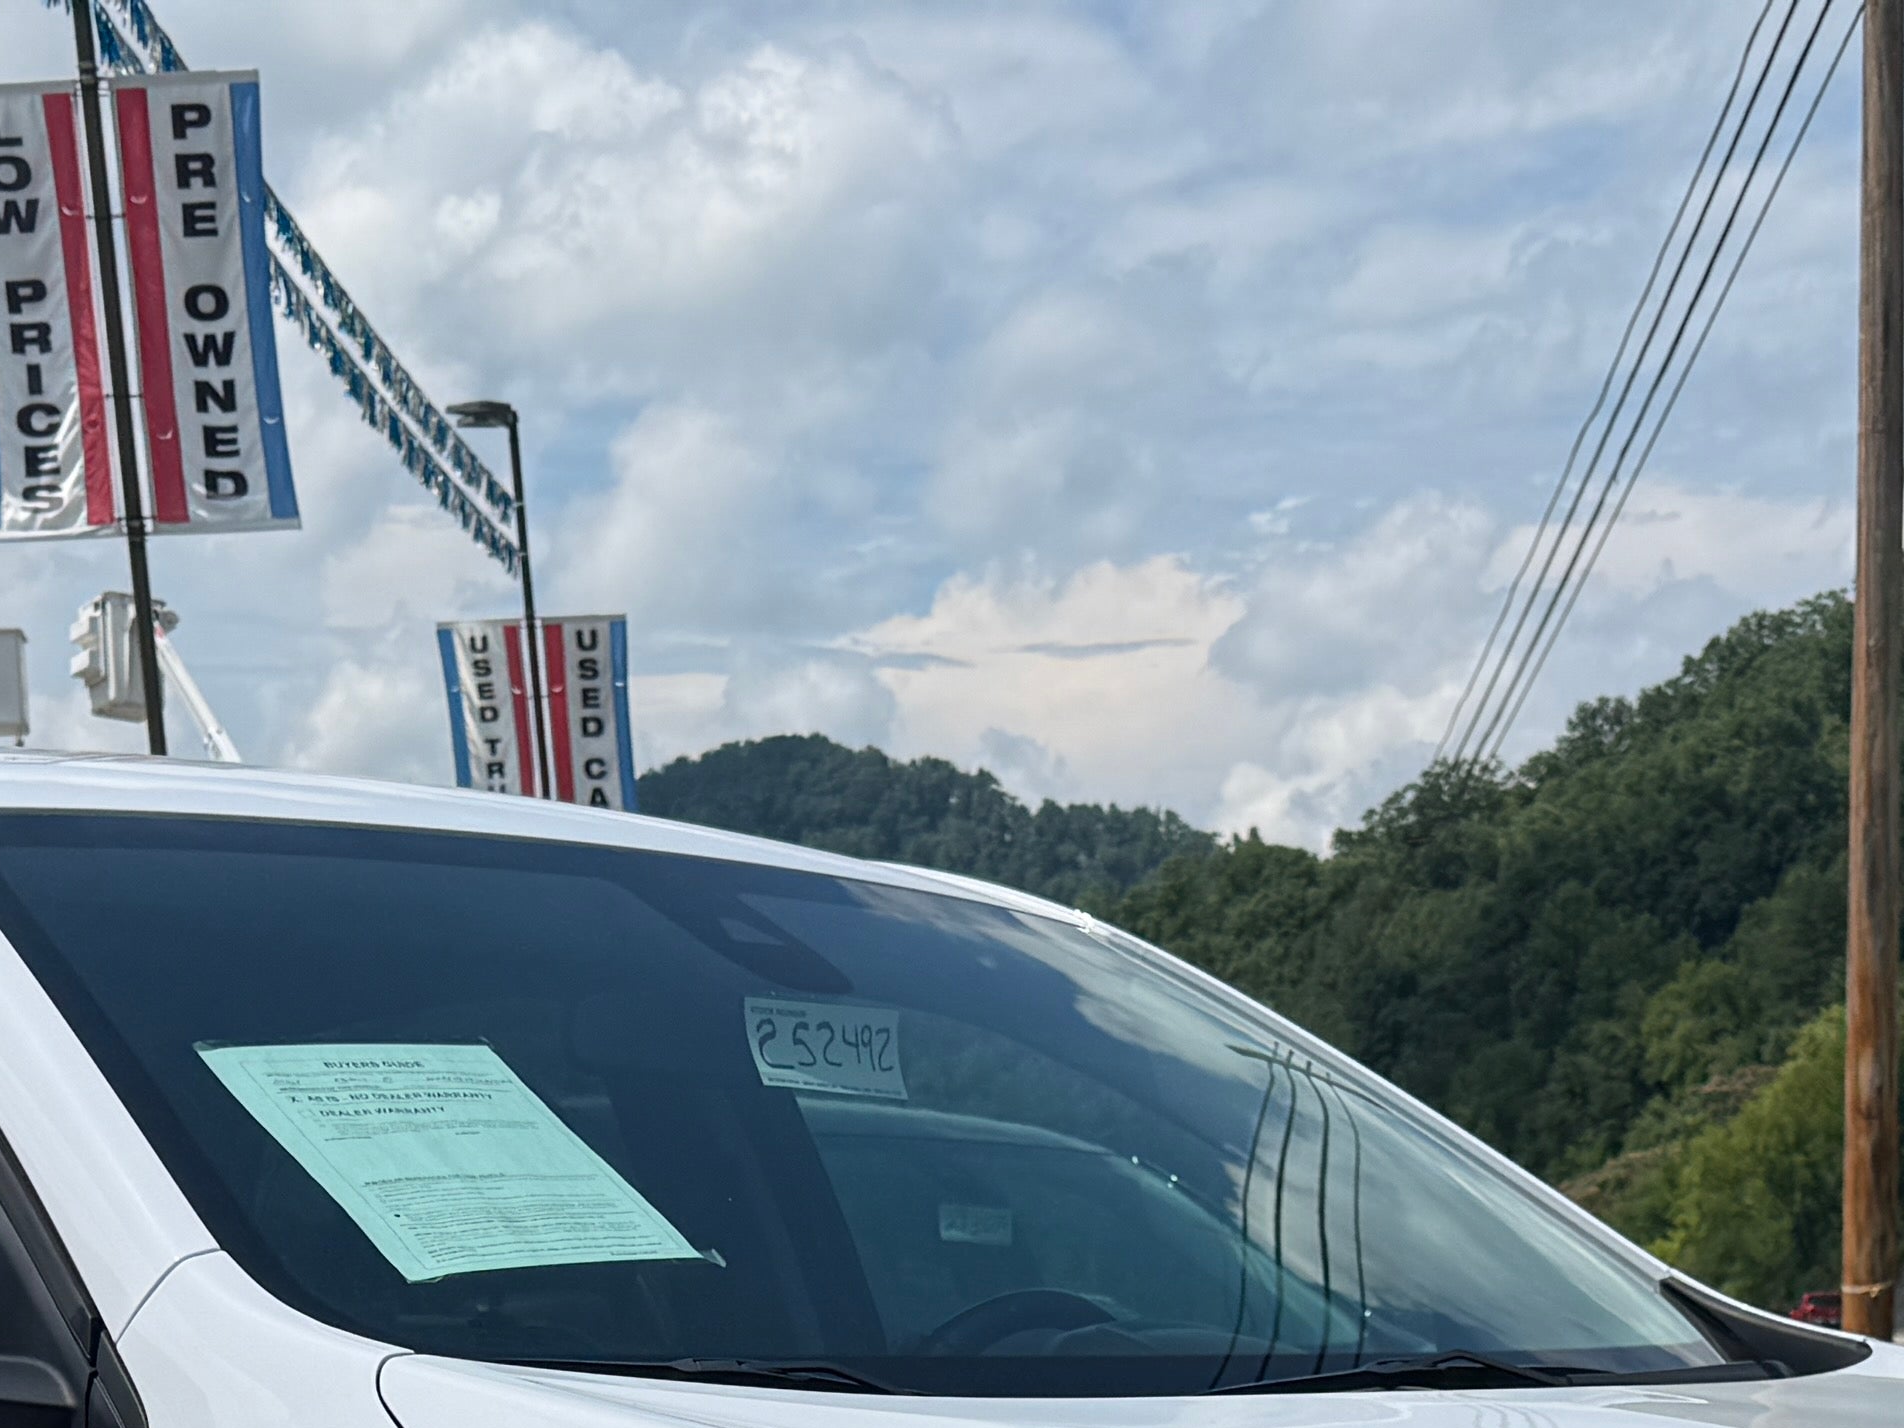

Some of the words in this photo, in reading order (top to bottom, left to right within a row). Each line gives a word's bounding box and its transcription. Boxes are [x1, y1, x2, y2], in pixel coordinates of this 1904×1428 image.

[171, 104, 216, 237] PRE
[5, 279, 64, 513] PRICES
[184, 285, 248, 499] OWNED
[470, 634, 499, 723] USED
[576, 629, 604, 738] USED
[323, 1060, 380, 1069] BUYERS
[382, 1060, 425, 1069] GUIDE
[757, 1018, 894, 1071] 252492
[319, 1107, 373, 1117] DEALER
[375, 1105, 445, 1115] WARRANTY
[371, 1092, 422, 1101] DEALER
[424, 1091, 493, 1101] WARRANTY
